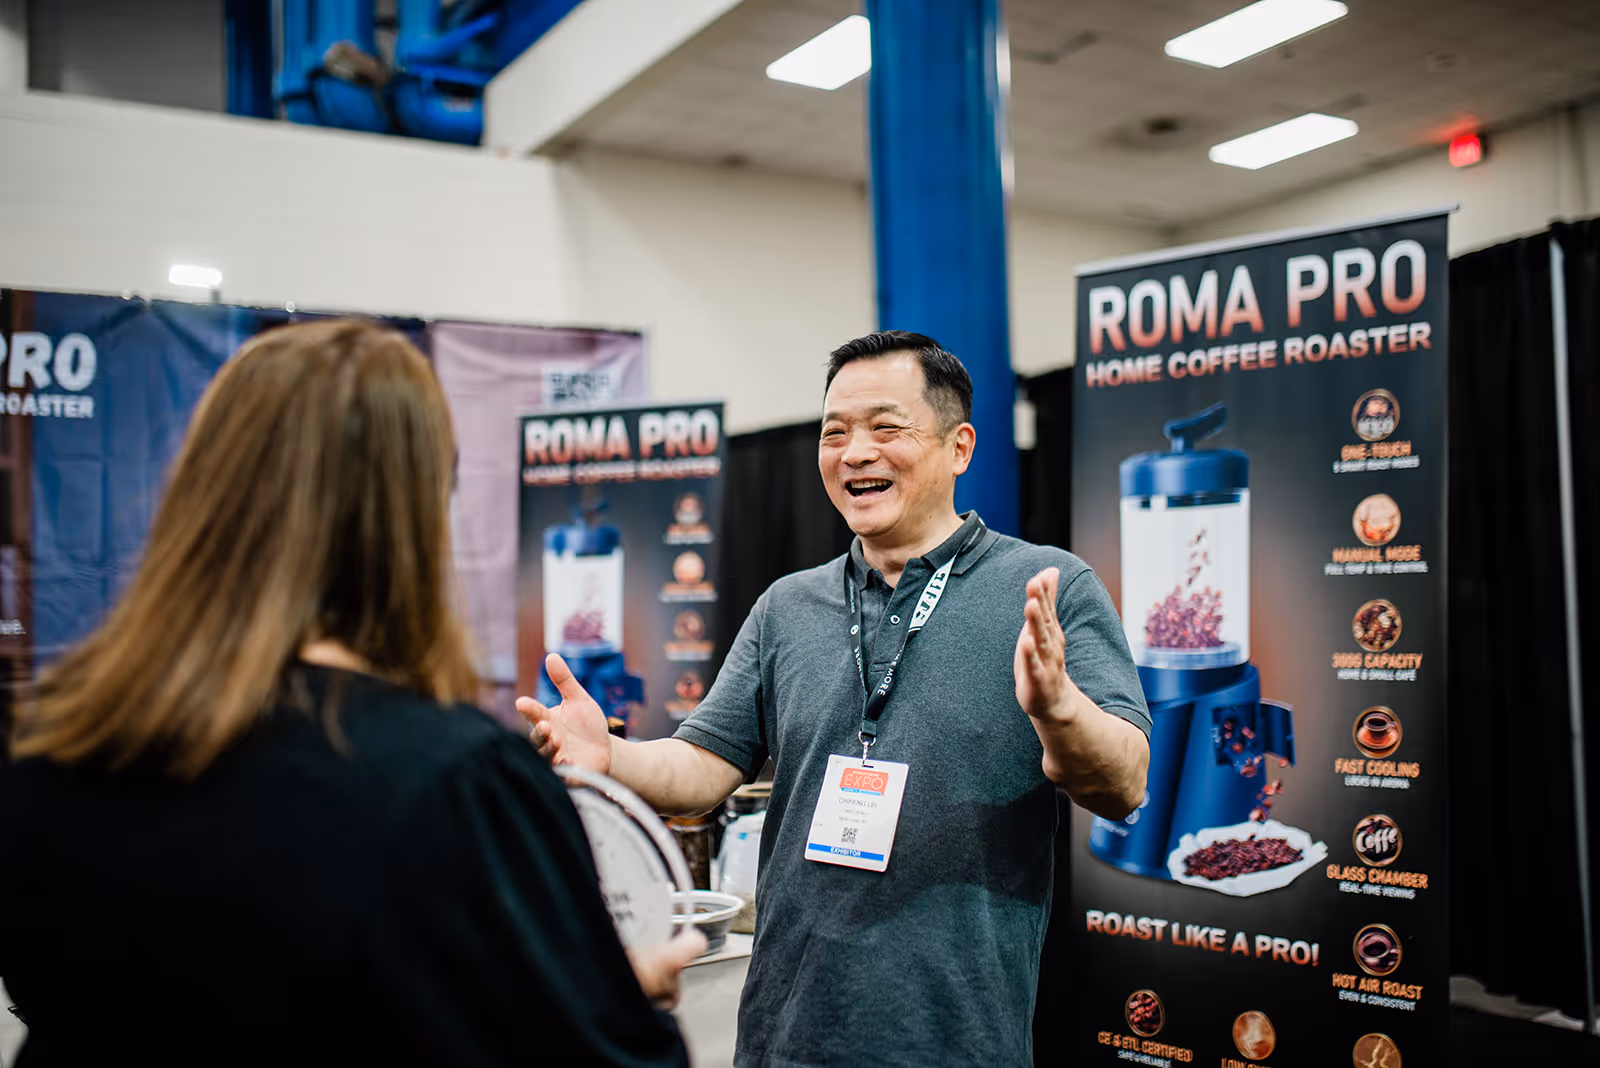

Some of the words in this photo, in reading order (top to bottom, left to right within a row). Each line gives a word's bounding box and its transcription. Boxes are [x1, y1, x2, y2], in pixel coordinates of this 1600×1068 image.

[1088, 265, 1265, 354] ROMA
[1286, 239, 1427, 328] PRO
[0, 331, 97, 391] RO
[1086, 354, 1163, 388] HOME
[1168, 340, 1277, 379] COFFEE
[1284, 322, 1431, 365] ROASTER
[525, 415, 631, 465] ROMA
[638, 408, 720, 458] PRO
[1385, 544, 1421, 561] MODE
[1331, 652, 1362, 669] 300G
[1364, 652, 1423, 669] CAPACITY
[877, 667, 894, 696] MORE
[844, 773, 884, 790] EXPO
[1335, 758, 1366, 775] FAST
[1366, 760, 1420, 778] COOLING
[830, 846, 861, 857] EXHIBITOR
[1326, 864, 1367, 882] GLASS
[1368, 868, 1429, 889] CHAMBER
[1086, 909, 1168, 942] ROAST
[1171, 922, 1227, 952] LIKE
[1231, 931, 1250, 957] A
[1255, 934, 1320, 967] PRO!
[1332, 972, 1357, 989] HOT
[1358, 977, 1381, 993] AIR
[1382, 981, 1424, 1000] ROAST
[1367, 995, 1416, 1011] CONSISTENT
[1098, 1031, 1113, 1045] CE
[1112, 1033, 1122, 1048] &
[1122, 1036, 1141, 1052] ETL
[1141, 1040, 1193, 1063] CERTIFIED
